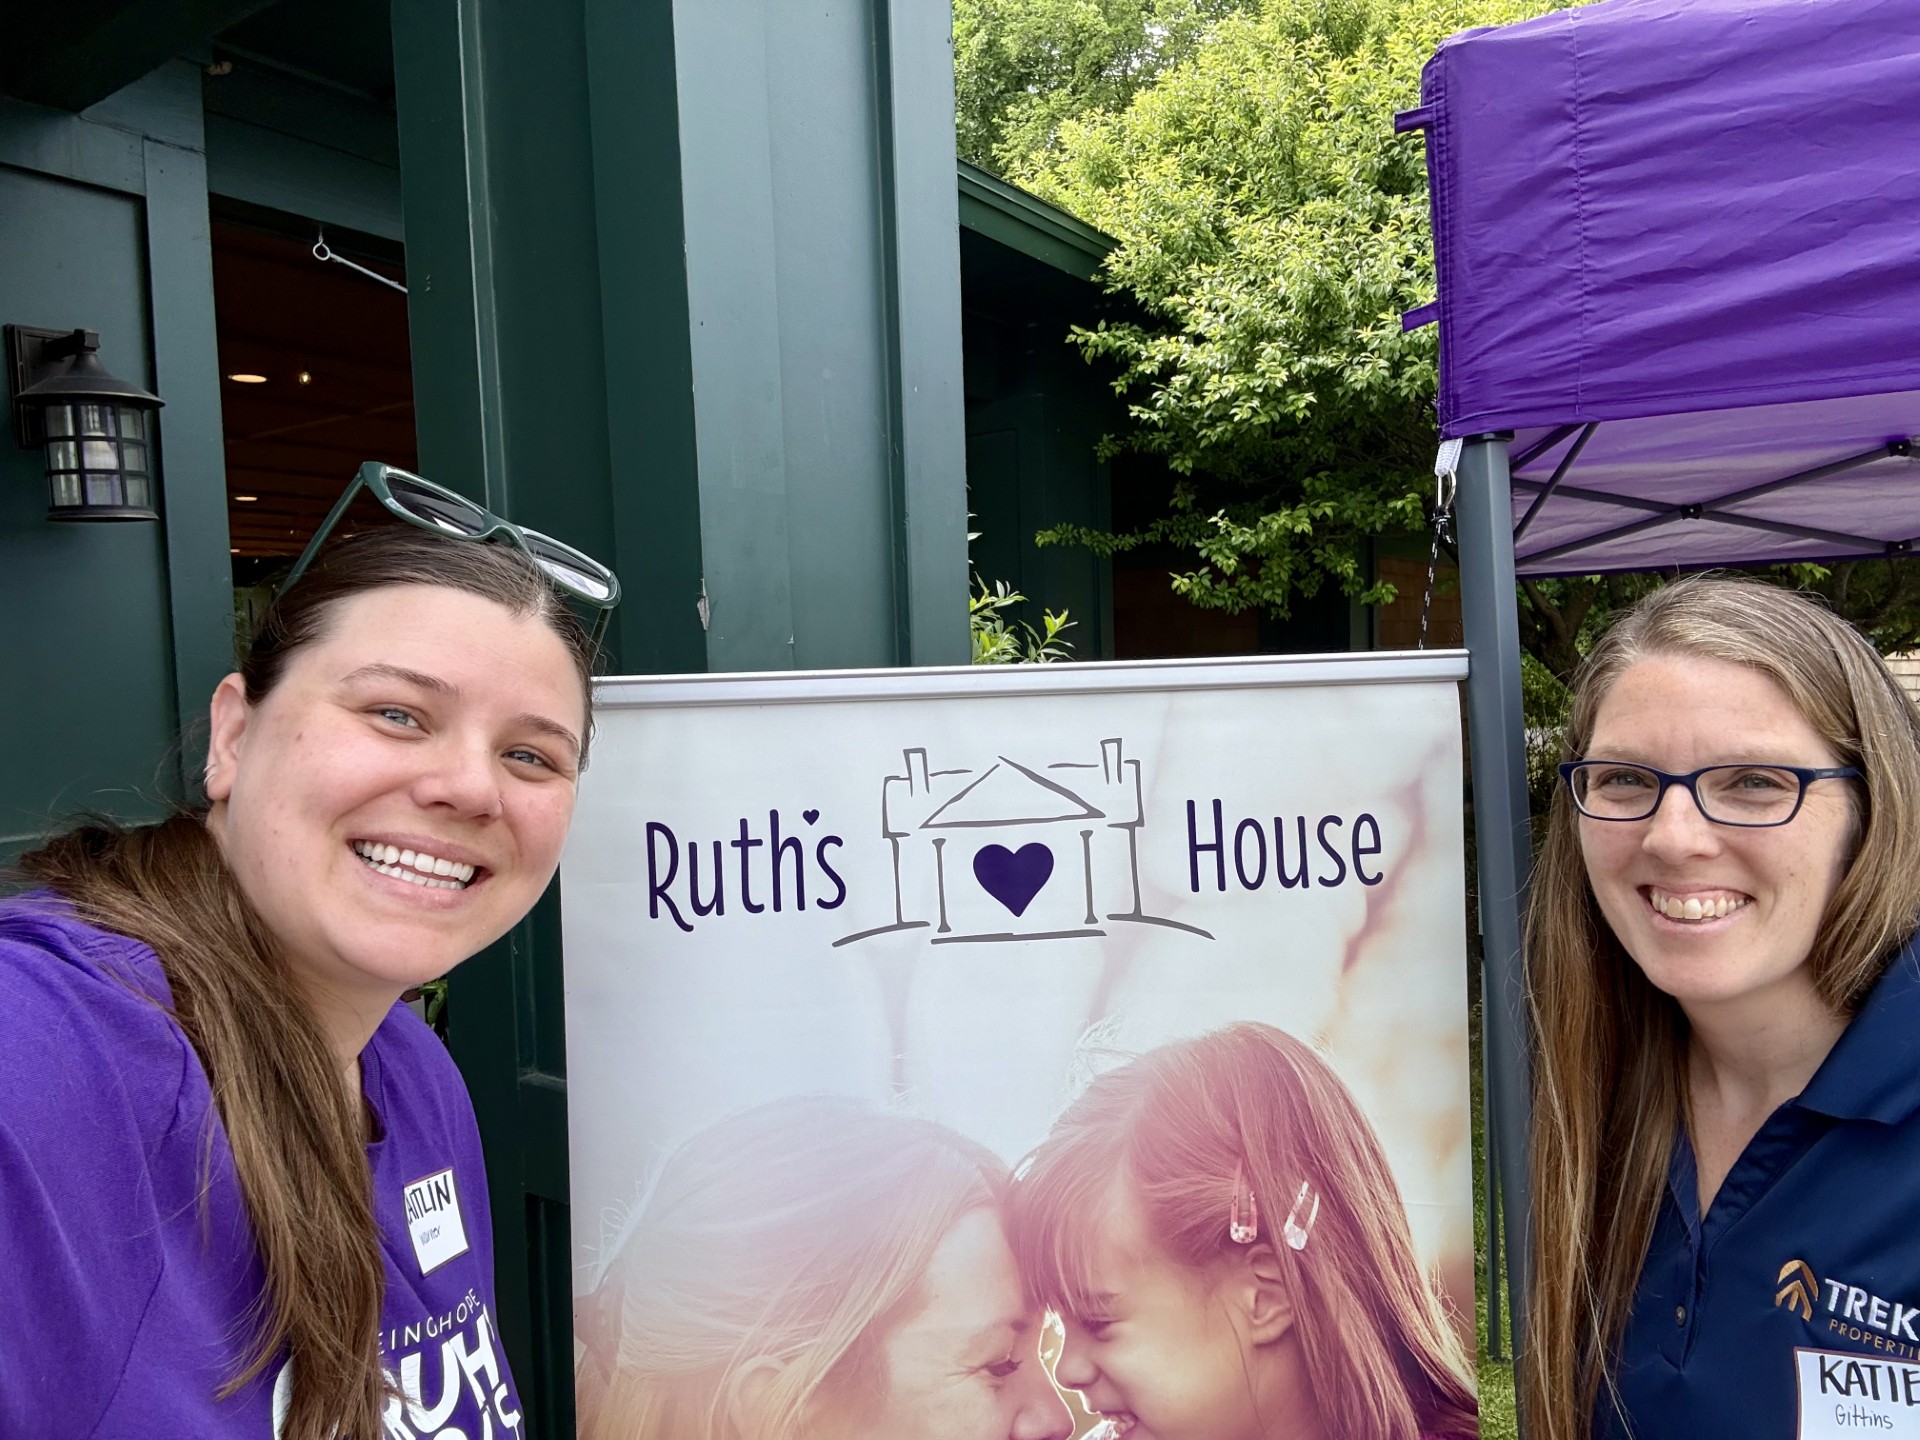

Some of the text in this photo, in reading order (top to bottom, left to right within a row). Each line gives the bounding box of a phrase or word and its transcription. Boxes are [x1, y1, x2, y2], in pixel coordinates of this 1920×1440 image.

[1187, 799, 1383, 892] House
[405, 1174, 451, 1225] AITLIN
[1825, 1278, 1920, 1341] TREK
[1829, 1319, 1920, 1360] PROPERTI
[1819, 1355, 1920, 1406] KATIE
[1835, 1404, 1893, 1429] Gittins
